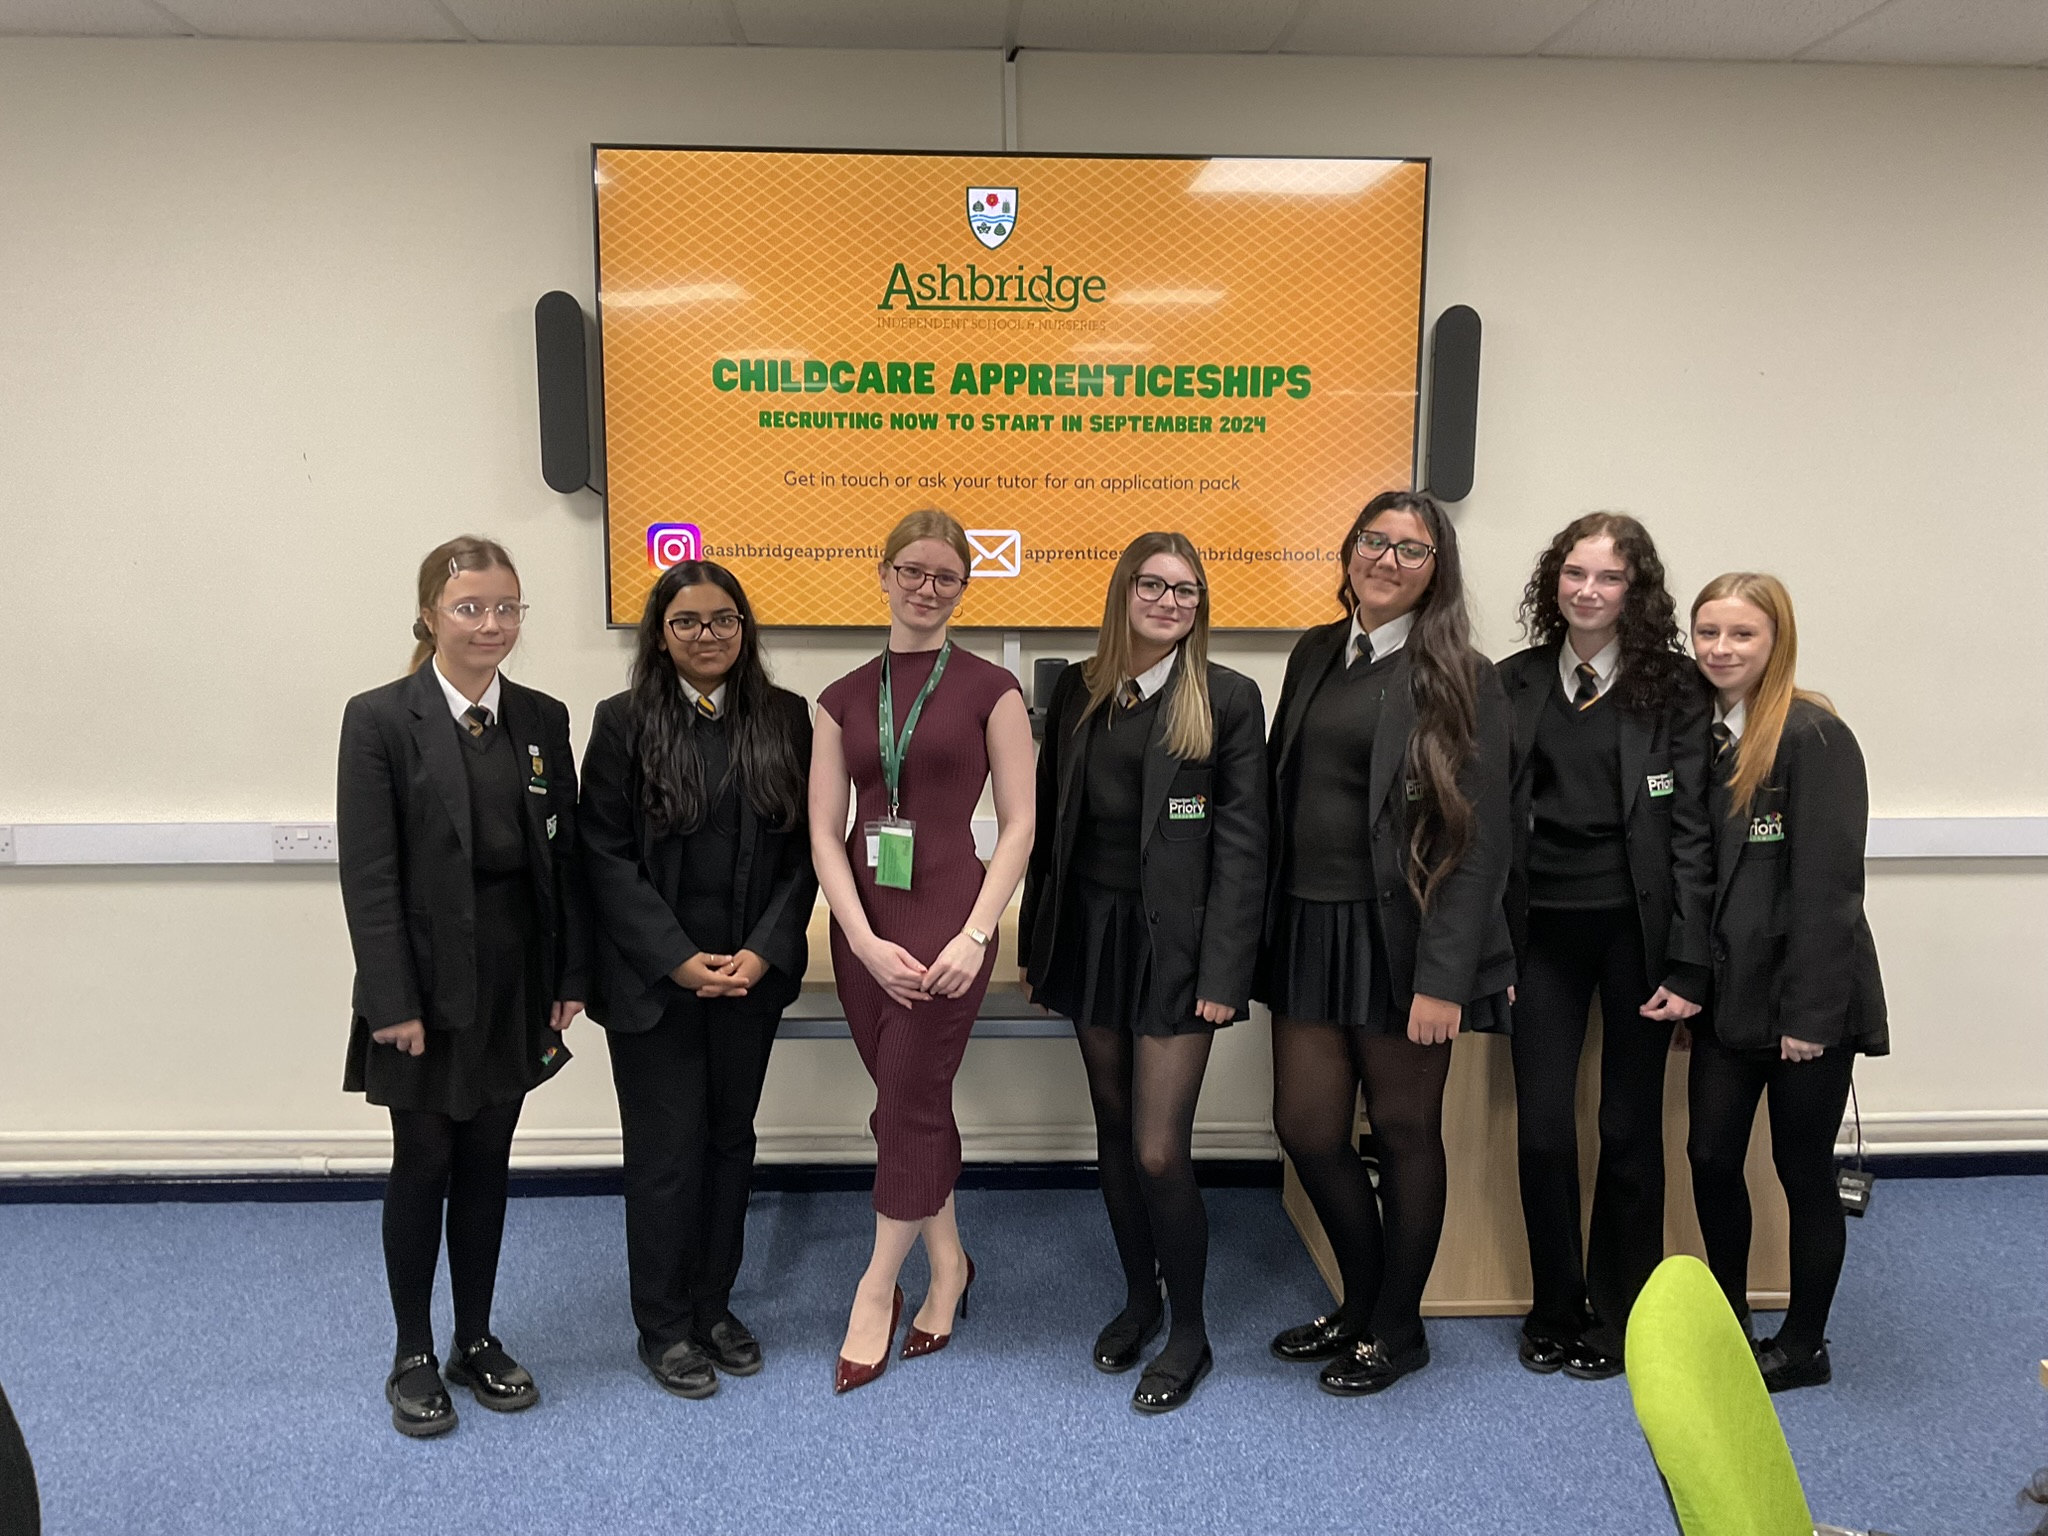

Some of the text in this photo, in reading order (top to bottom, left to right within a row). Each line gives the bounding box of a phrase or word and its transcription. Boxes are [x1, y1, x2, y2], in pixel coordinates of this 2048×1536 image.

[877, 262, 1106, 312] Ashbridge
[877, 316, 968, 331] INDEPENDENT
[971, 318, 1024, 331] SCHOOL
[1039, 319, 1106, 332] NURSERIES
[712, 358, 1312, 399] CHILDCARE APPRENTICESHIPS
[759, 410, 1267, 433] RECRUITING NOW TO START IN SEPTEMBER 2024
[783, 470, 1241, 494] Get in touch or ask your tutor for an application pack
[701, 543, 886, 561] @ashbridgeapprentic
[1169, 801, 1205, 815] Priory
[1749, 820, 1783, 836] riory
